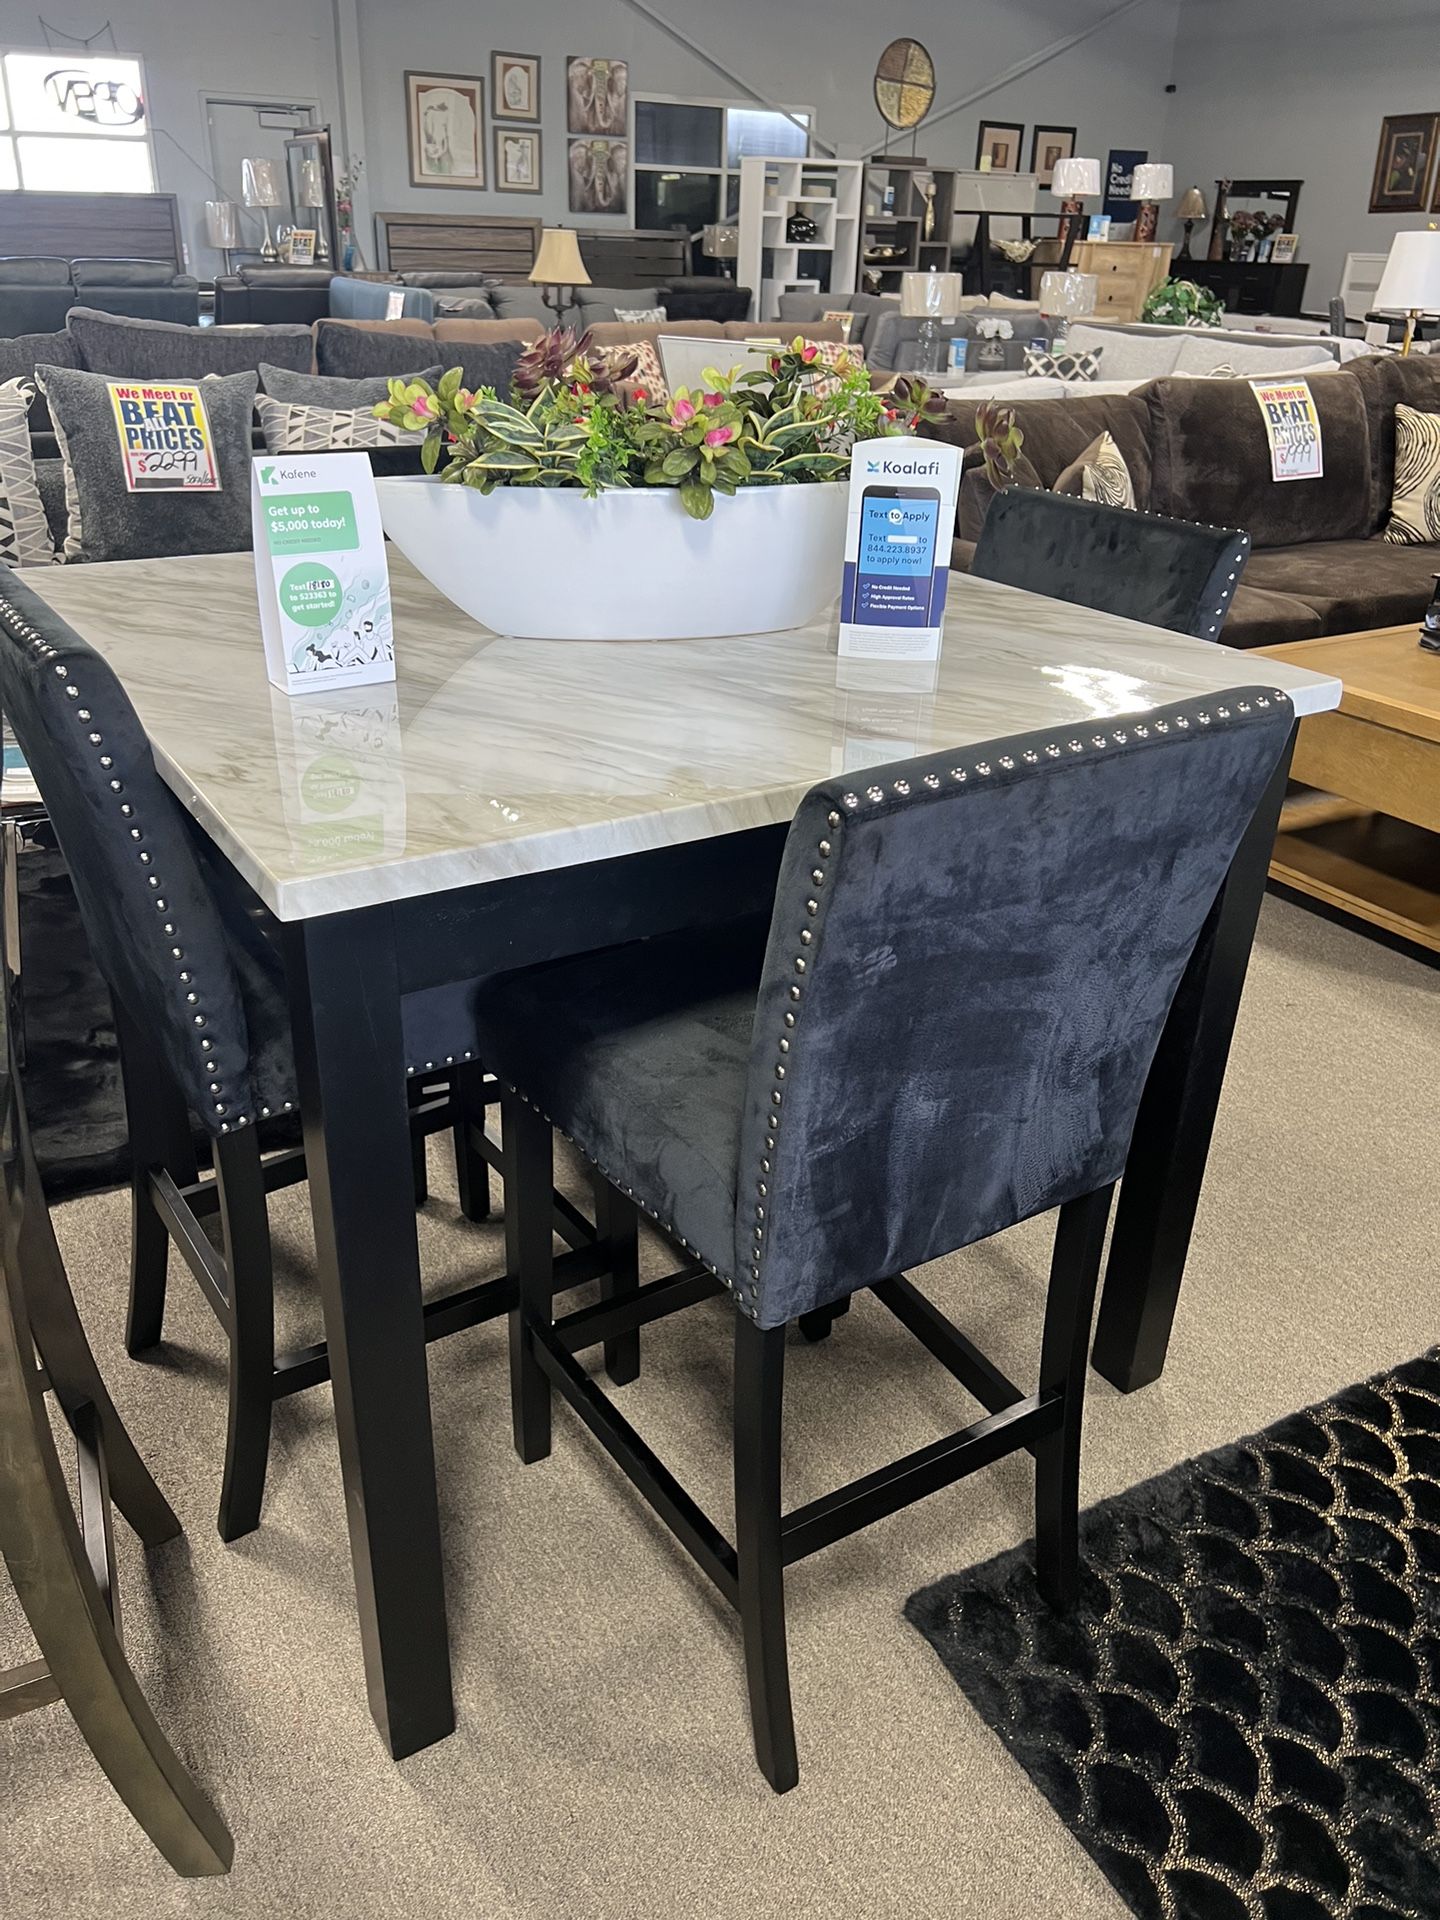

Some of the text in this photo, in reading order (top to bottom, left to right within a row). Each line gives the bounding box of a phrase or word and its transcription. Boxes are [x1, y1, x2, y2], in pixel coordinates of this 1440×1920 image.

[1110, 162, 1123, 173] No
[116, 387, 193, 401] We Meet or
[1260, 390, 1306, 402] We Meet or
[120, 400, 196, 426] BEAT
[1266, 400, 1309, 425] BEAT
[144, 417, 169, 432] ALL
[126, 428, 205, 450] PRICES
[1273, 424, 1316, 445] PRICES
[280, 469, 317, 480] Kafene
[883, 461, 940, 476] Koalafi
[268, 504, 320, 517] Get up to
[869, 510, 930, 522] Text to Apply
[271, 515, 346, 533] $5,000 today!
[868, 534, 928, 544] Text to
[867, 544, 927, 554] 844.223.8937
[867, 555, 922, 566] to apply now!
[289, 583, 305, 591] Text
[292, 601, 335, 613] get started!
